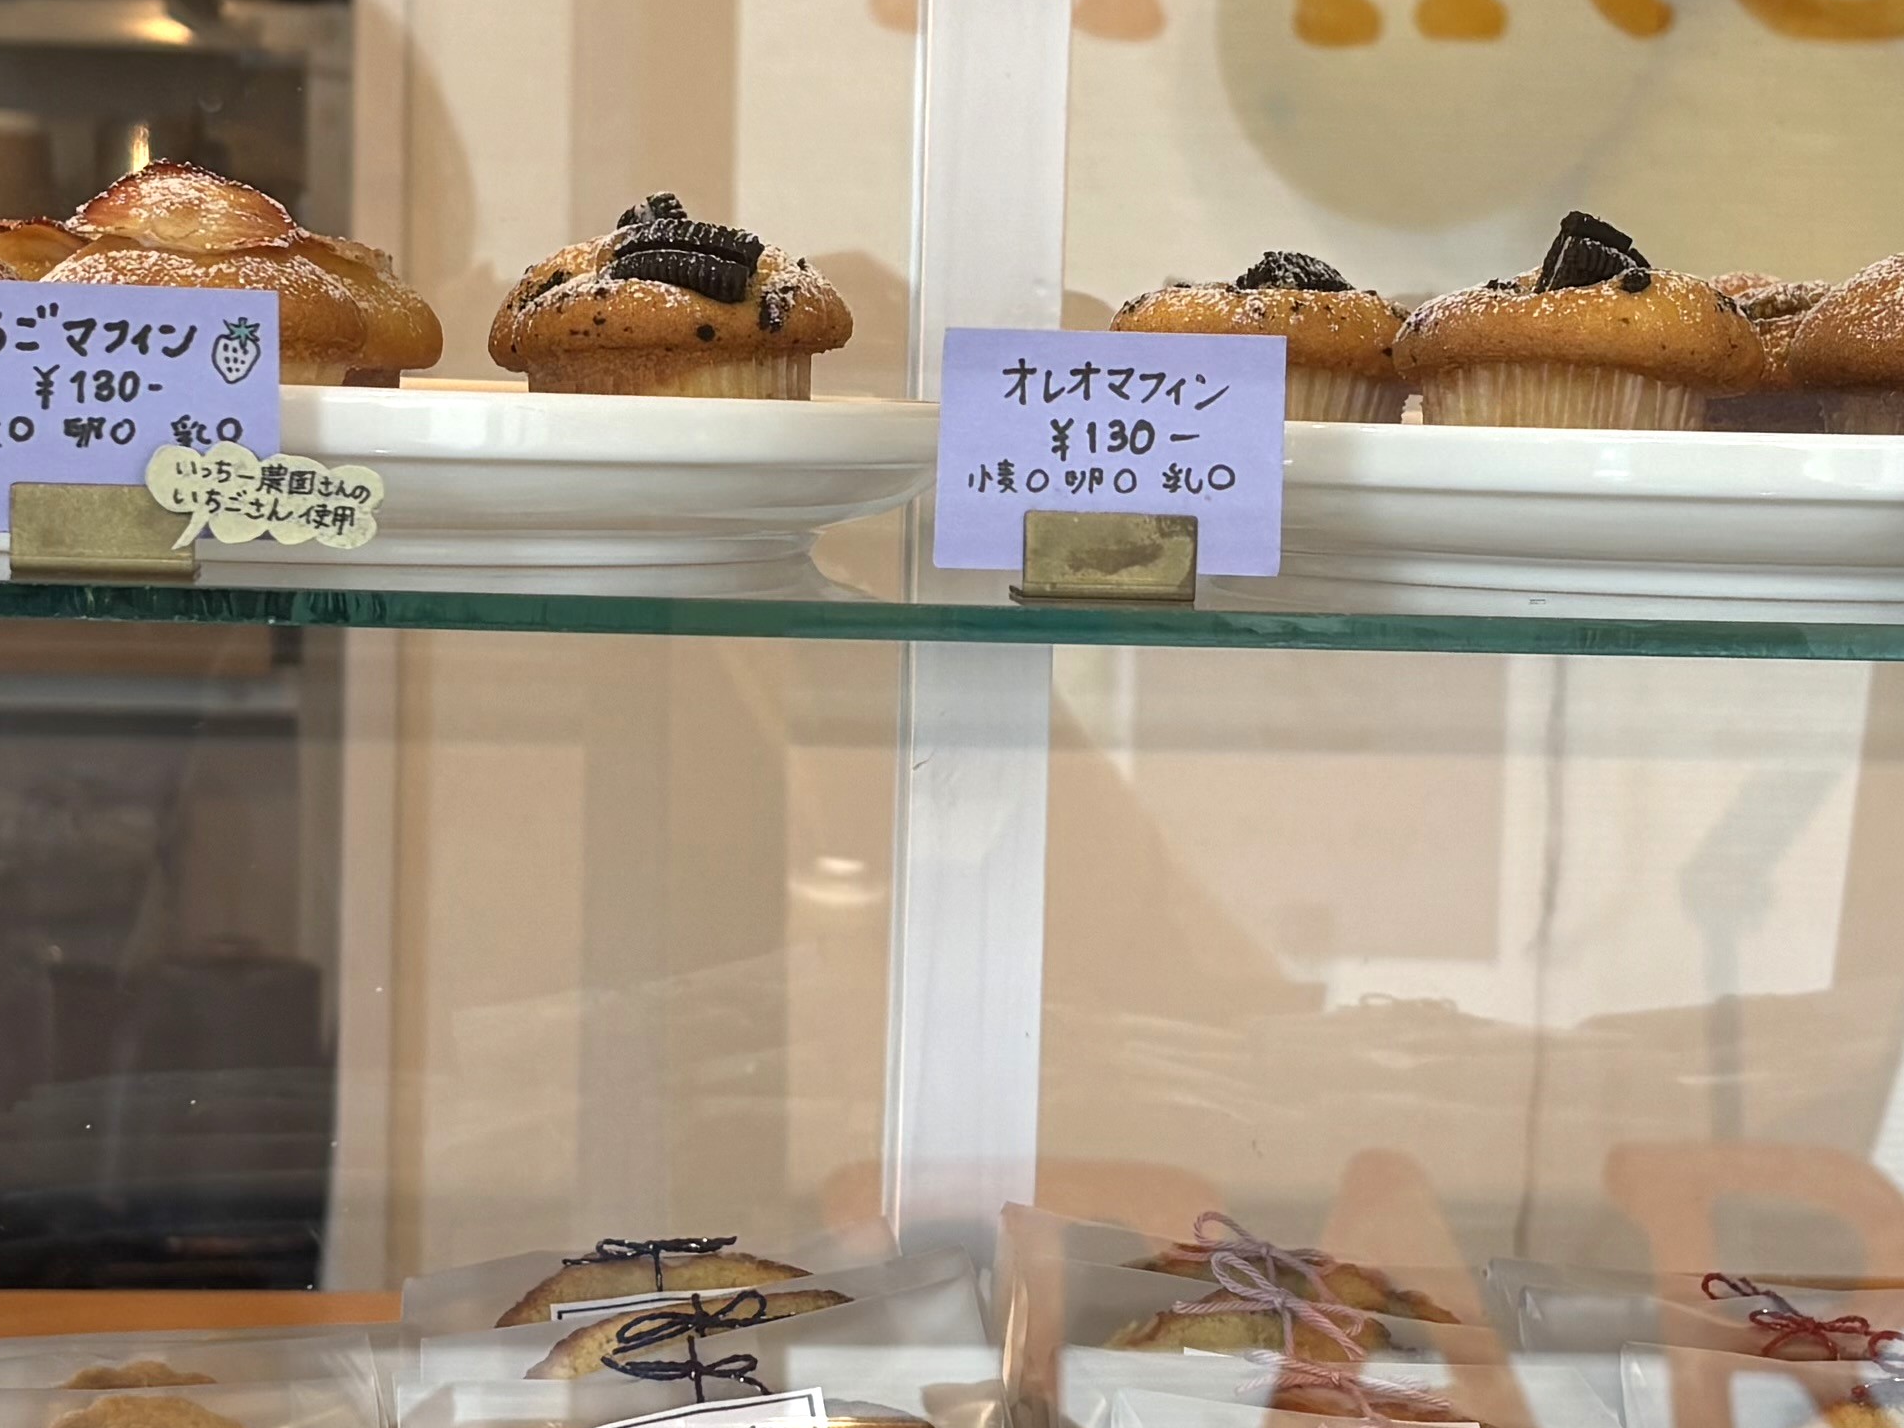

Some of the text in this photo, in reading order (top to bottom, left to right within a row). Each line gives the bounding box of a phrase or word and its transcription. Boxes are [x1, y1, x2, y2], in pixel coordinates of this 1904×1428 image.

[1001, 357, 1231, 411] オレオマフィン
[172, 487, 356, 536] いちごさん使用
